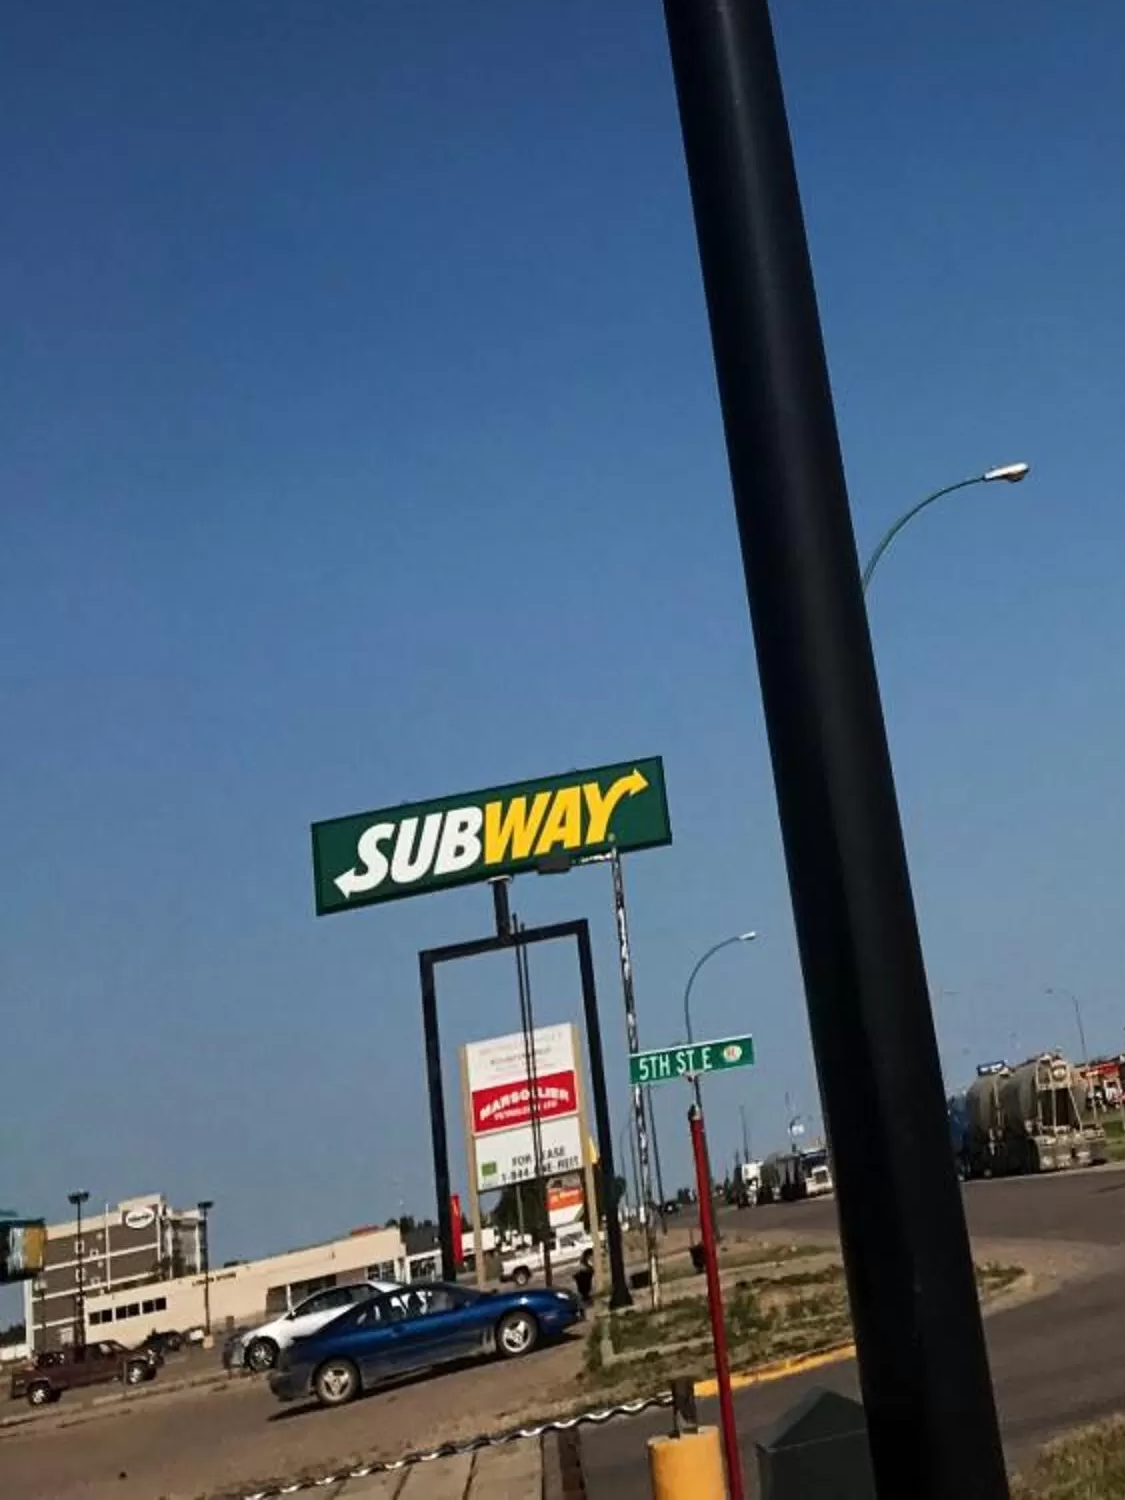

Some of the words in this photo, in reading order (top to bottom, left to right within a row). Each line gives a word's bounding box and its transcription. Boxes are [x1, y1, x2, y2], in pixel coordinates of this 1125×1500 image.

[333, 767, 649, 899] SUBWAY
[639, 1053, 671, 1081] 5TH
[676, 1049, 696, 1075] ST
[701, 1046, 713, 1070] E
